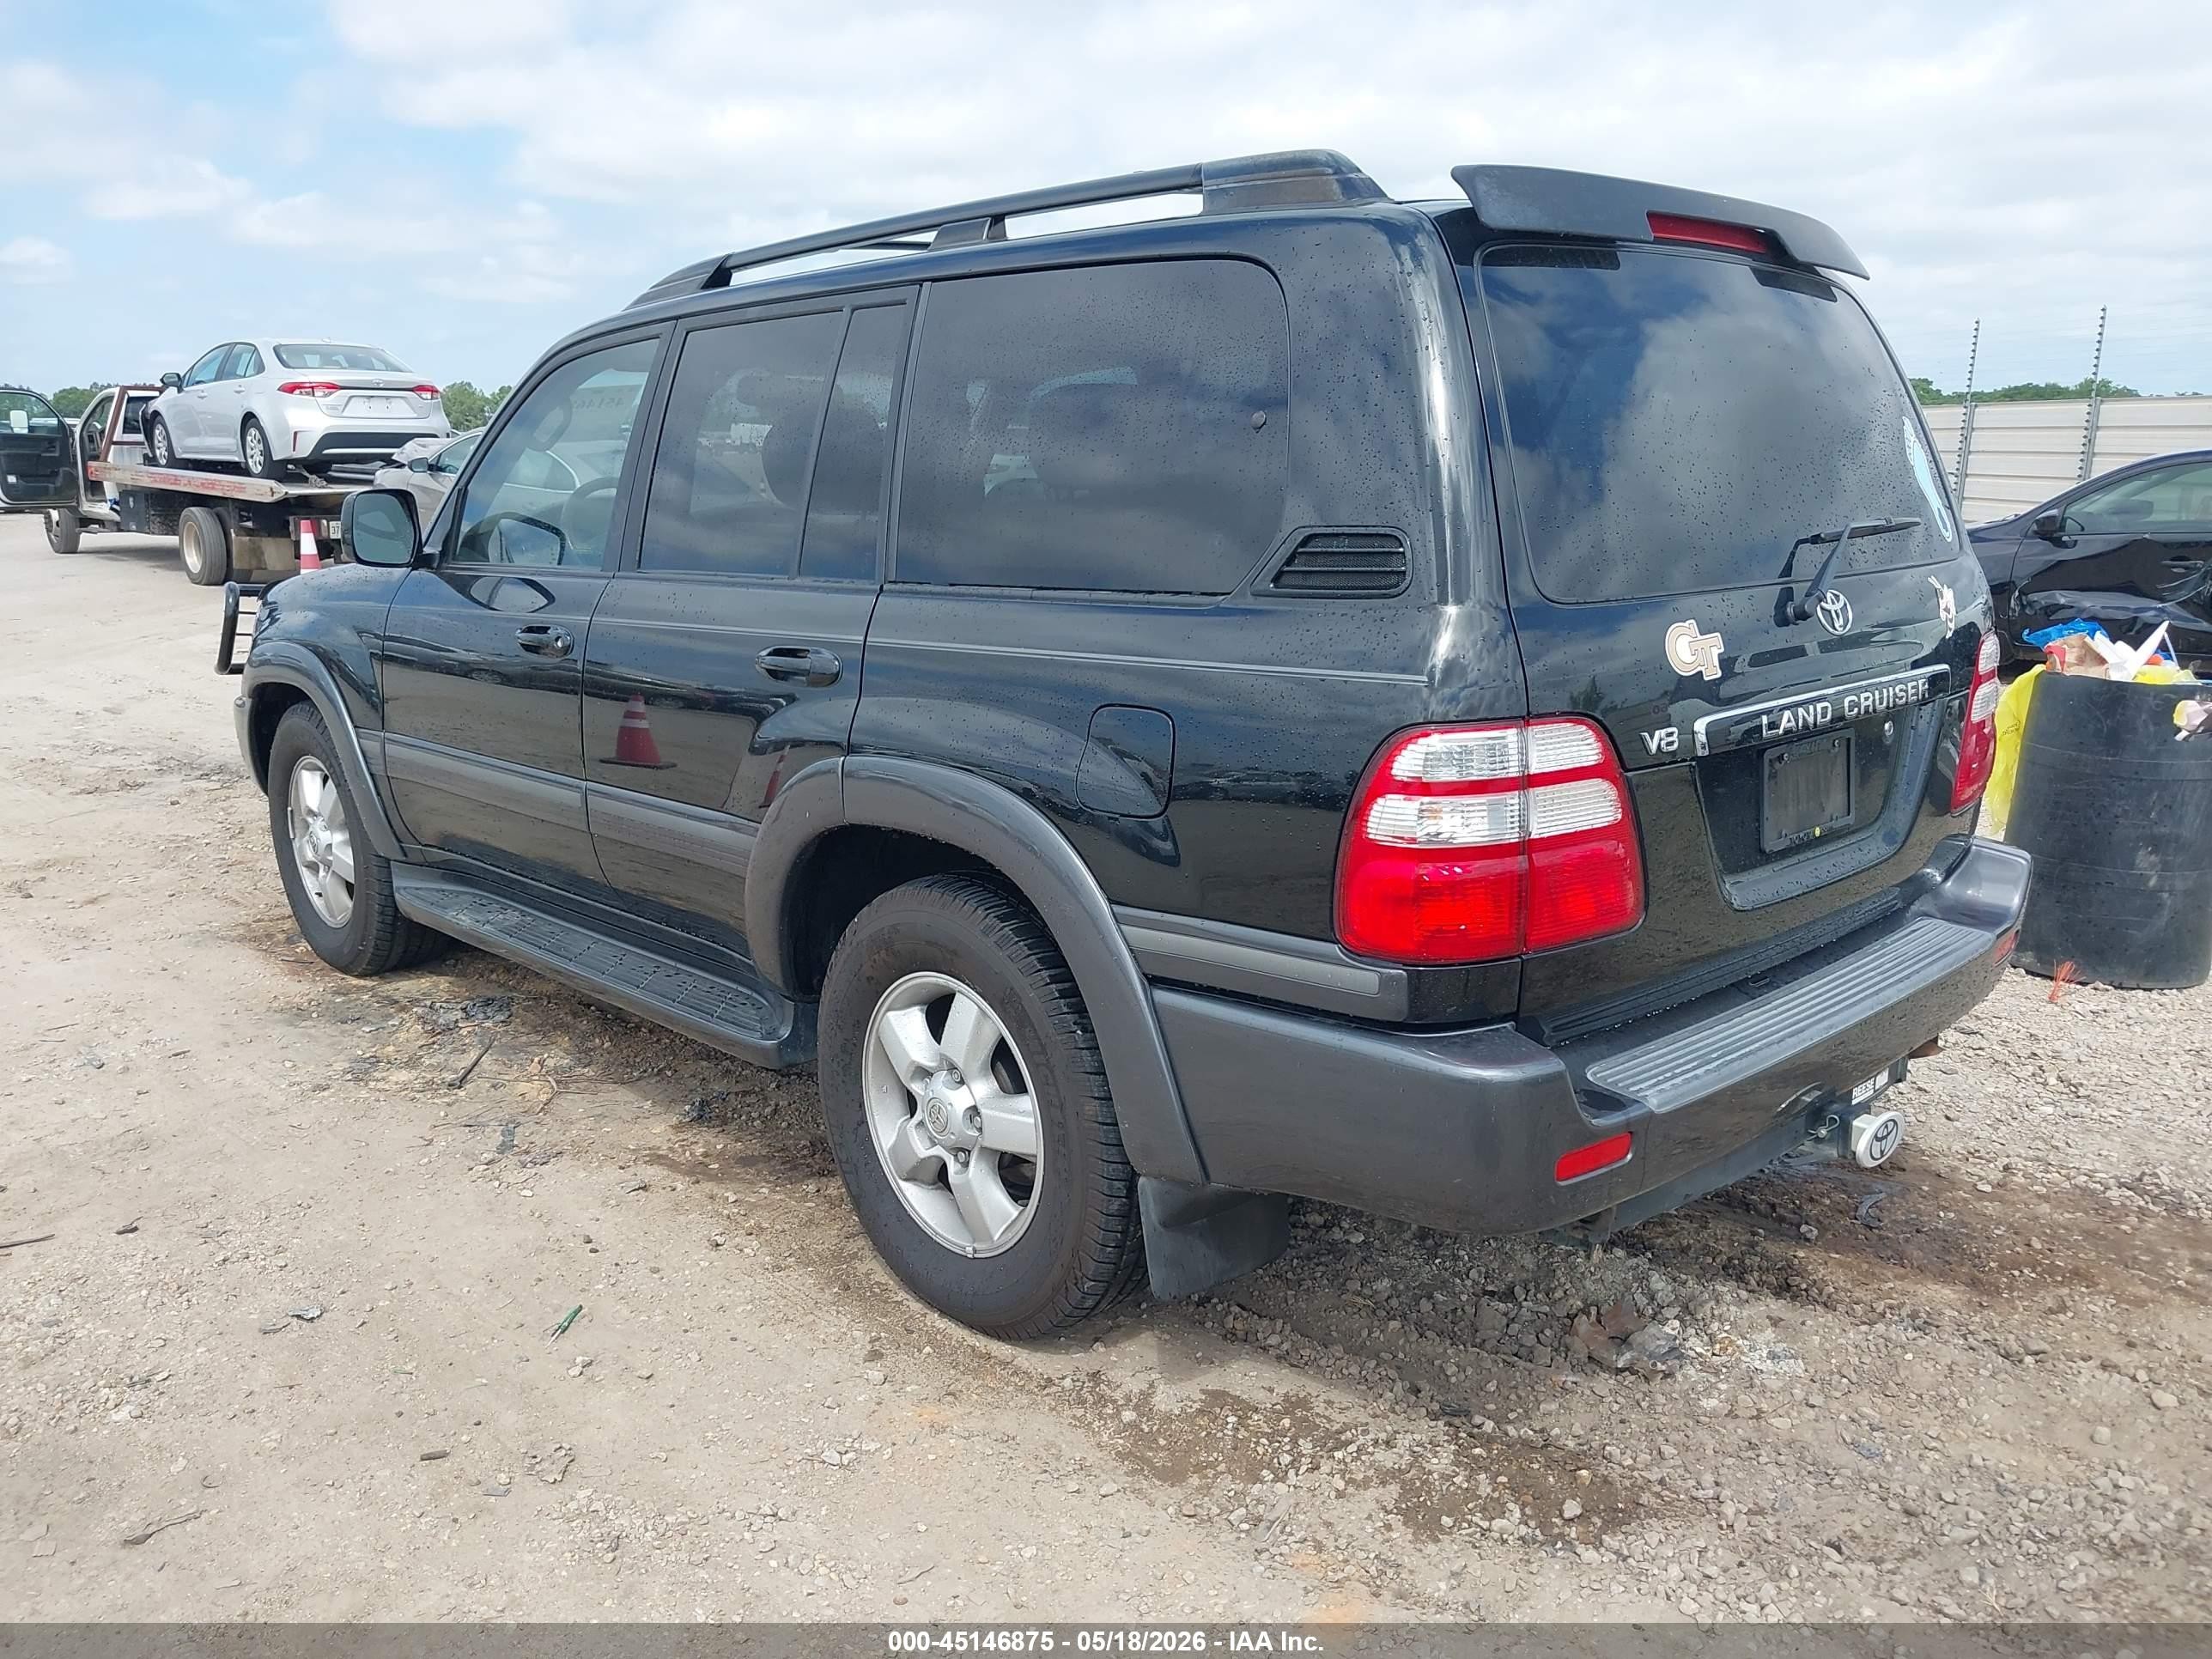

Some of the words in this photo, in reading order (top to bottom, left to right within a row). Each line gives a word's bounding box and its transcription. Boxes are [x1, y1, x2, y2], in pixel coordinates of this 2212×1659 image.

[1666, 620, 1723, 679] GT
[1761, 701, 1832, 738] LAND
[1844, 678, 1929, 718] CRUISER
[1639, 726, 1679, 756] V8
[1852, 1077, 1875, 1100] REESE
